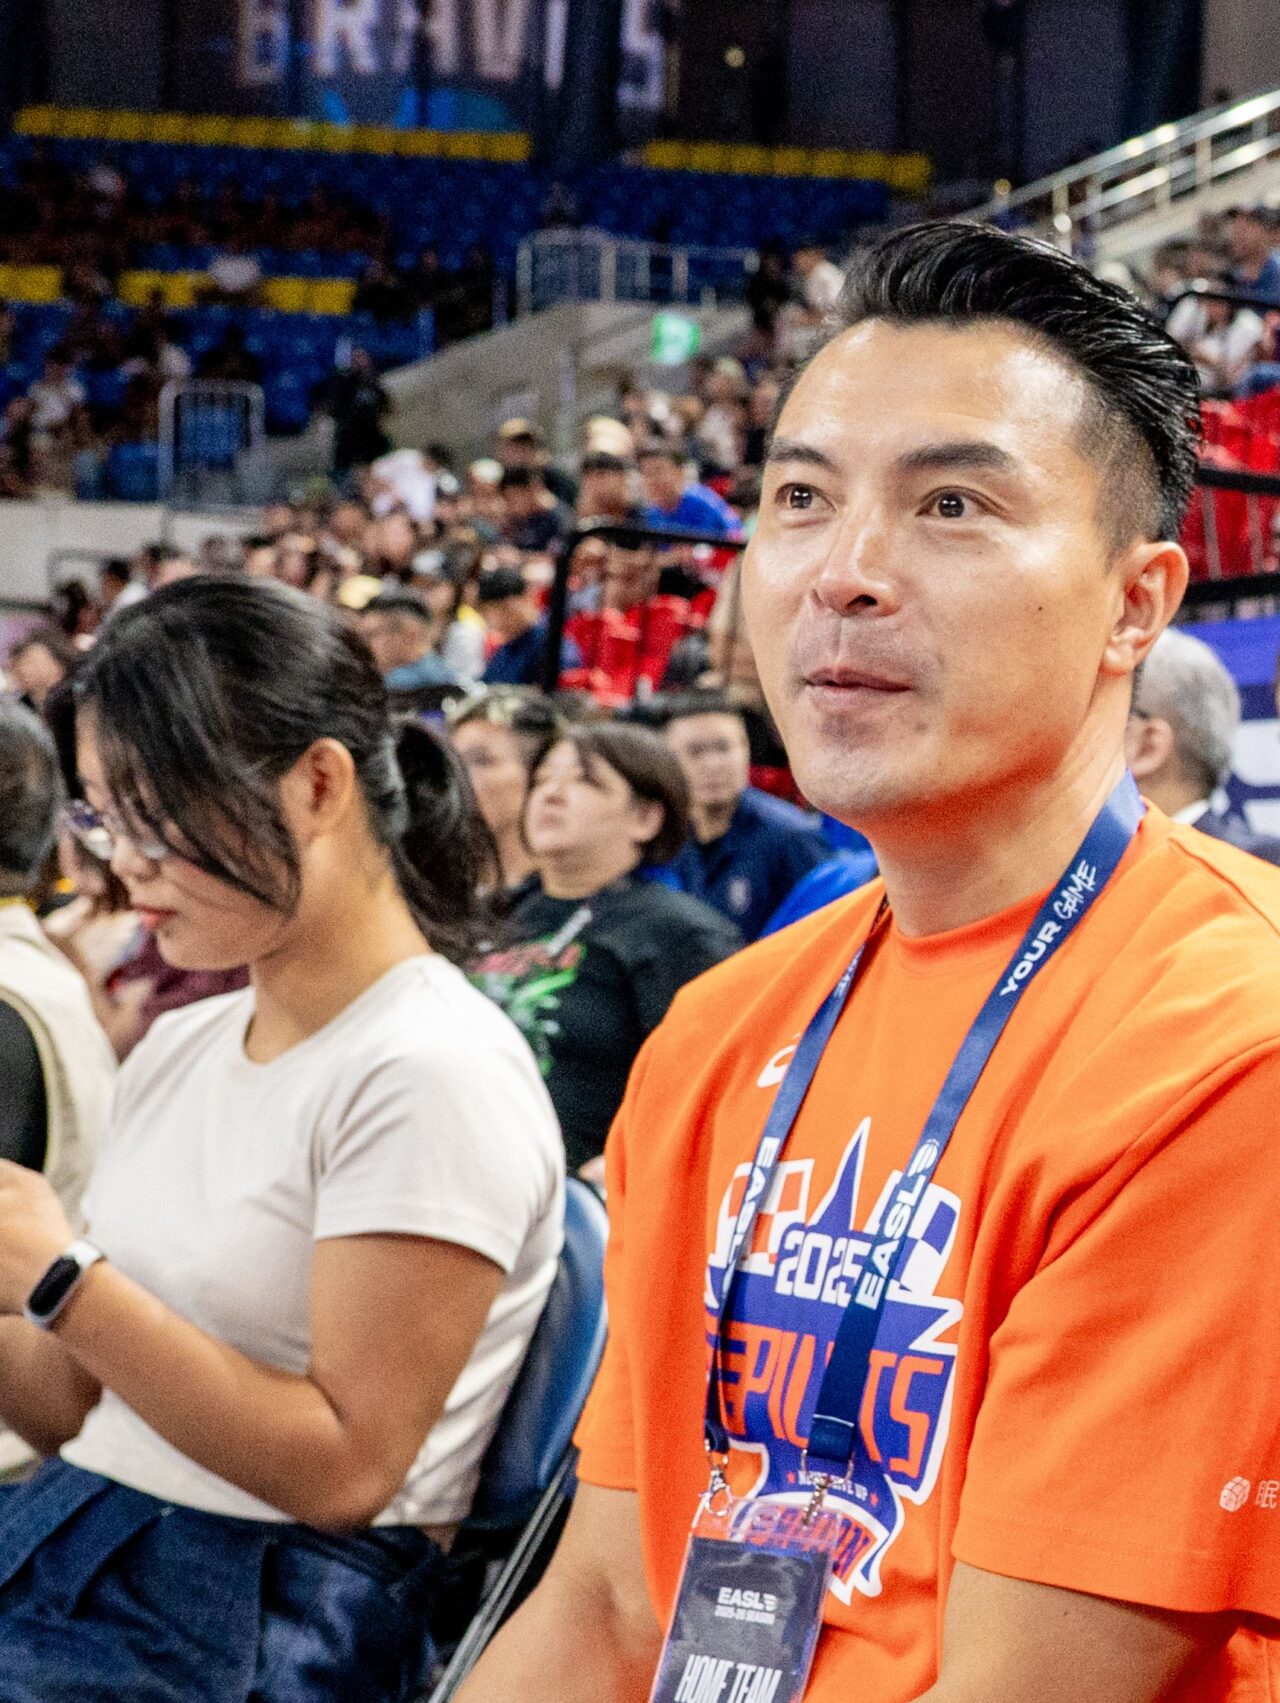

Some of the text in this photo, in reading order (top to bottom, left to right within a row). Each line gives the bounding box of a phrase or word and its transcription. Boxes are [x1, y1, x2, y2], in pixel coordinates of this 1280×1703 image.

[1000, 860, 1097, 996] YOUR GAME
[775, 1229, 872, 1308] 2025
[855, 1174, 927, 1310] EASL
[706, 1318, 945, 1480] PILTS
[717, 1586, 764, 1609] EASL
[674, 1653, 783, 1703] HOME TEAM
